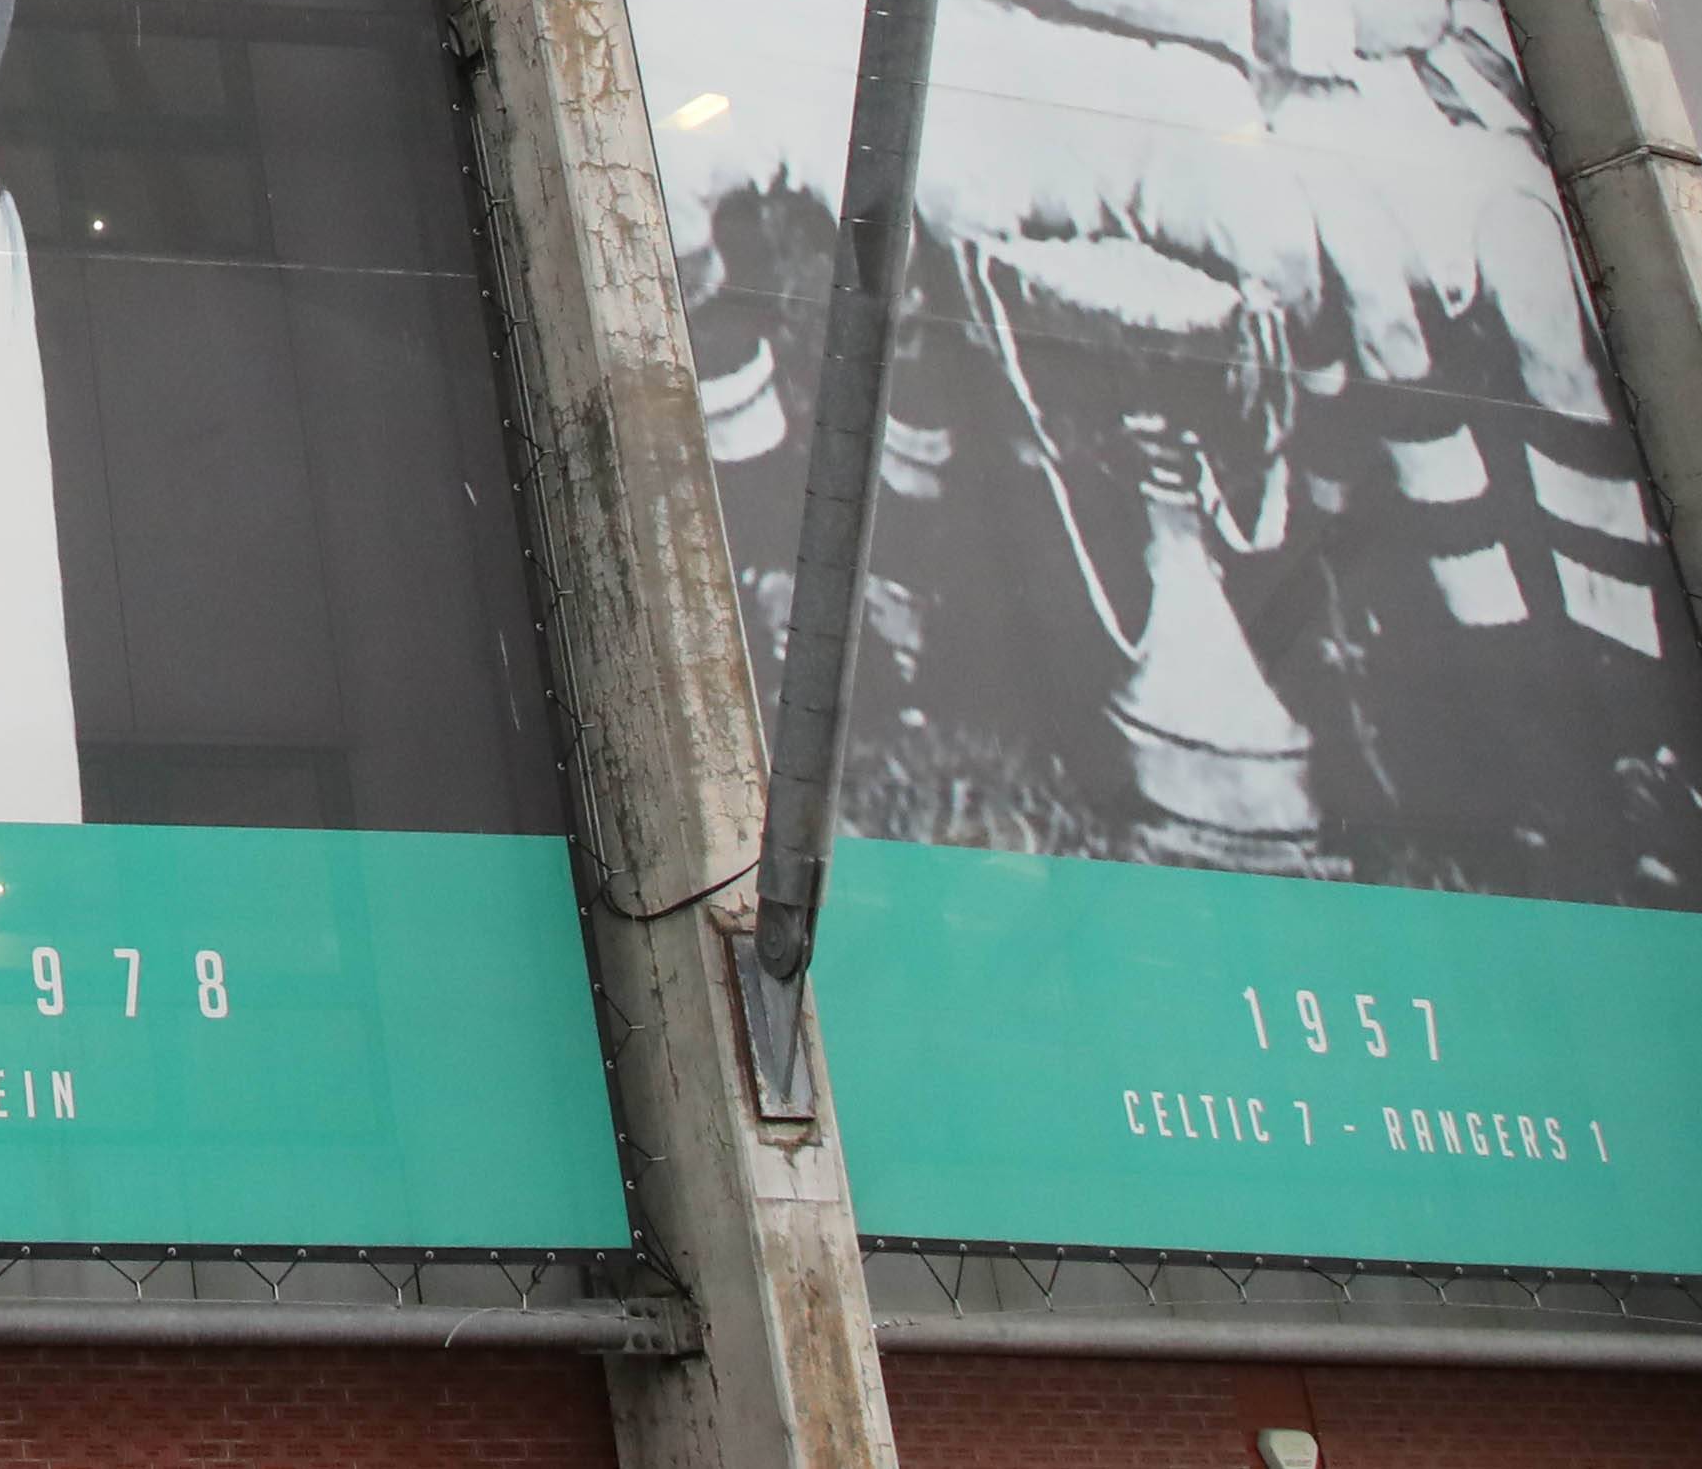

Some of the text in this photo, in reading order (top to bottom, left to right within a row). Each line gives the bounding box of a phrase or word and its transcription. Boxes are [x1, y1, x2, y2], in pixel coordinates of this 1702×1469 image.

[1242, 986, 1442, 1063] 1957
[1123, 1088, 1272, 1145] CELTIC
[1293, 1100, 1315, 1146] 7
[1382, 1105, 1570, 1163] RANGERS
[1590, 1120, 1610, 1163] 1
